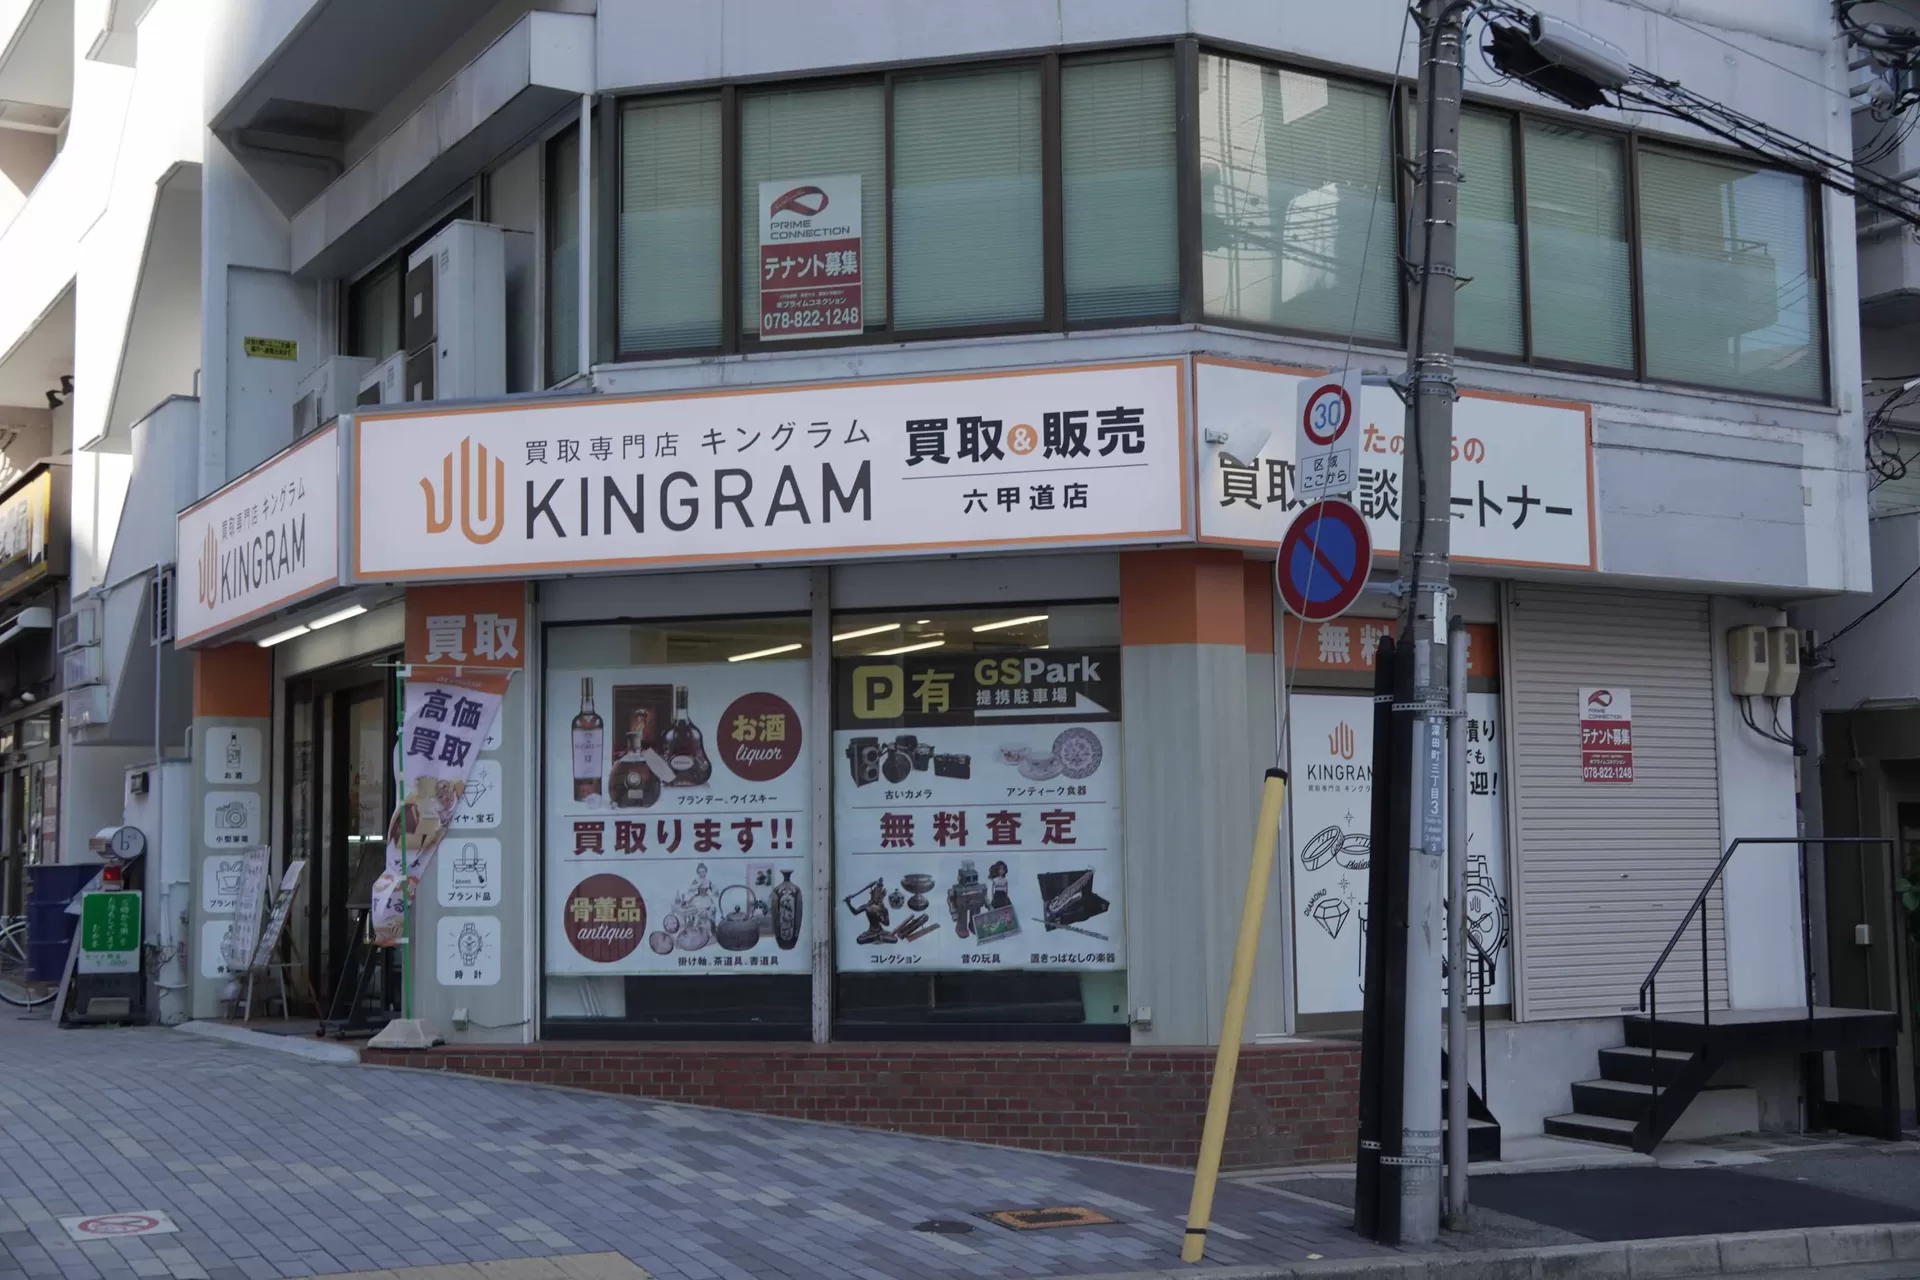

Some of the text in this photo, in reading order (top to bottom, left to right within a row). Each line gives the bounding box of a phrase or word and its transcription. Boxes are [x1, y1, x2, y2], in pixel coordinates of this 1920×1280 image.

[770, 219, 812, 230] PRIME
[770, 226, 850, 240] CONNECTION
[765, 250, 858, 280] テナント募集
[764, 307, 859, 330] 078-822-1248
[1314, 400, 1342, 430] 30
[525, 420, 871, 466] 買取専門店 キングラム
[905, 406, 1146, 466] 買取&販売
[1303, 469, 1348, 490] ここから
[263, 477, 305, 519] キングラム
[526, 460, 872, 539] KINGRAM
[963, 482, 1089, 514] 六甲道店
[221, 512, 306, 604] KINGRAM
[425, 614, 519, 663] 買取
[974, 656, 1102, 686] GSPark
[865, 676, 894, 711] P
[912, 668, 955, 714] 有
[976, 687, 1069, 706] 提携駐車場
[419, 688, 484, 731] 高価
[731, 714, 786, 743] お酒
[1583, 728, 1631, 746] テナント募集
[406, 726, 473, 769] 買取
[735, 744, 783, 767] liquor
[1583, 766, 1633, 779] 078-822-1248
[884, 788, 932, 800] 古いカメラ
[1006, 785, 1088, 797] アンティーク食器
[573, 817, 794, 855] 買取ります!!
[879, 808, 1077, 848] 無料査定
[570, 896, 641, 923] 骨董品
[1303, 888, 1327, 917] DIAMOND
[577, 923, 635, 946] antique
[870, 953, 922, 965] コレクション
[961, 952, 1001, 964] 昔の玩具
